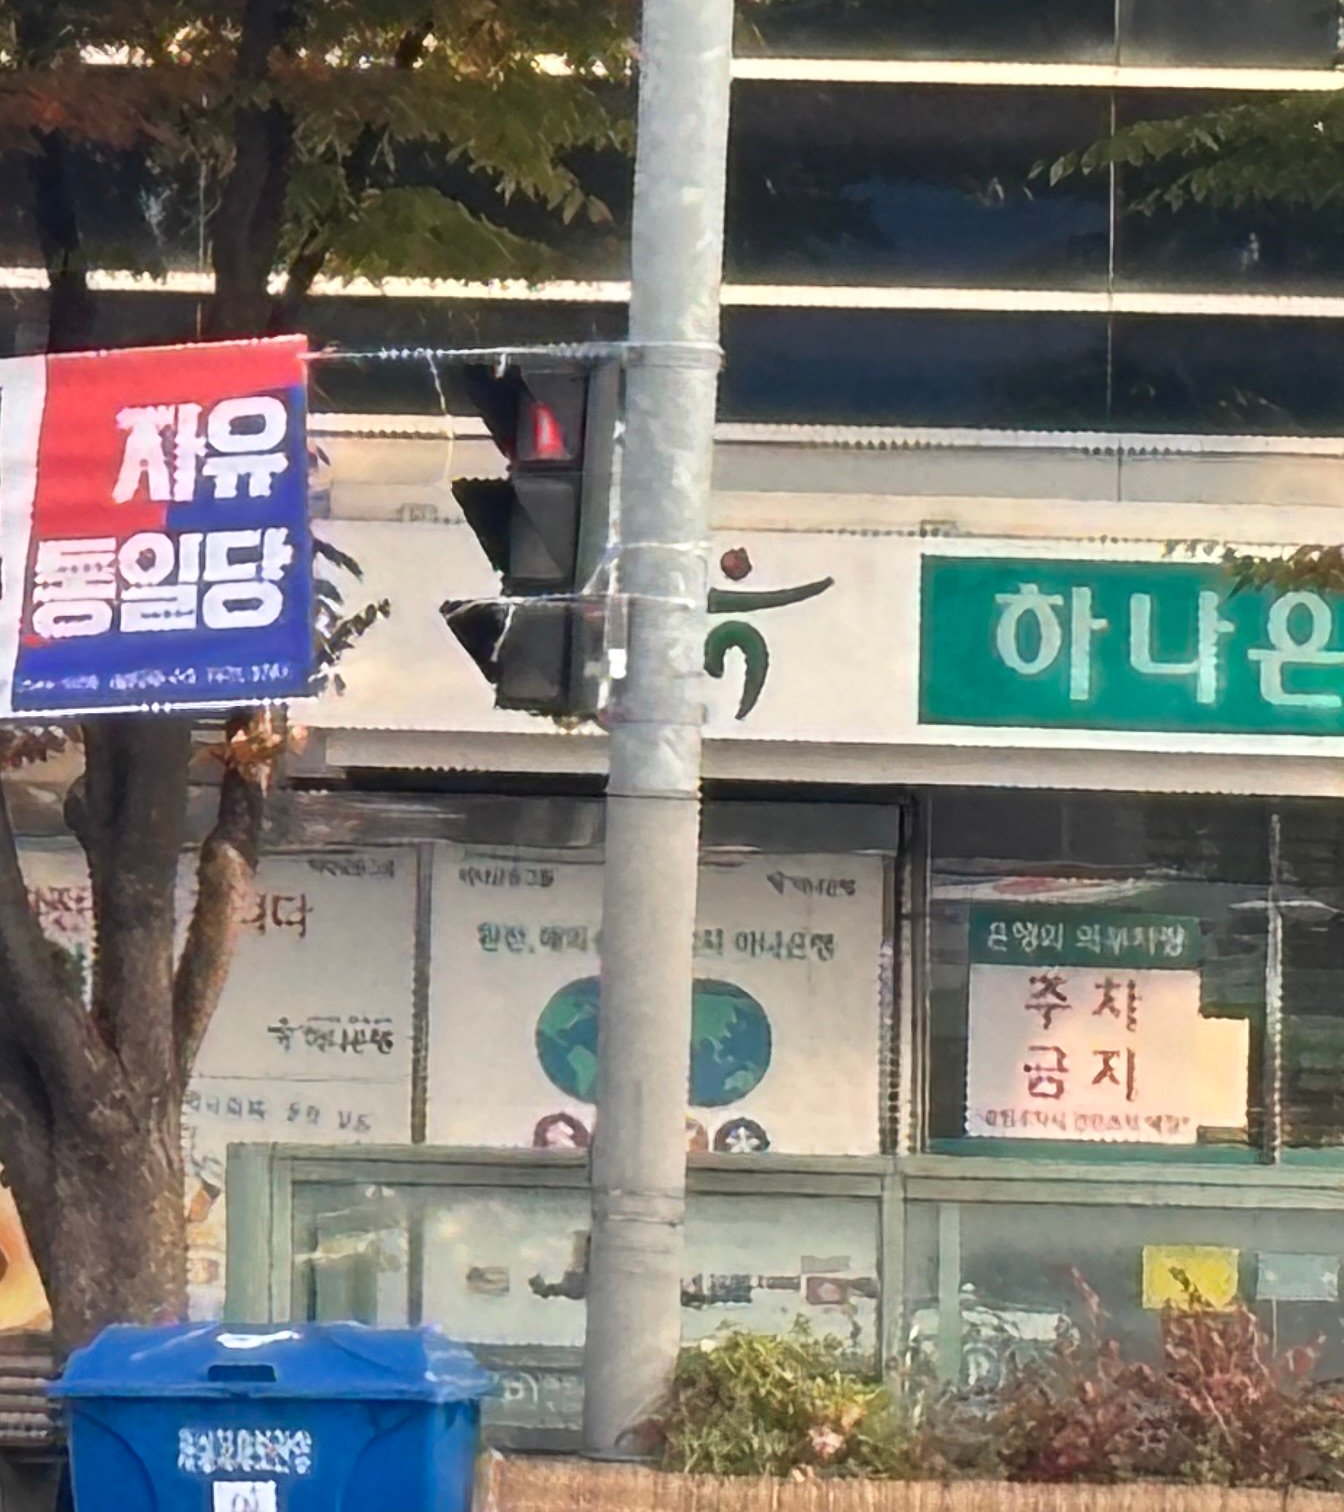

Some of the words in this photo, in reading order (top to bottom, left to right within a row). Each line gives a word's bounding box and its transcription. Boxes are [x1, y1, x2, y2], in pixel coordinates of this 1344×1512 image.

[113, 395, 288, 503] 자유
[31, 526, 295, 640] 통일당
[1024, 973, 1141, 1032] 주차
[1023, 1044, 1138, 1103] 금지
